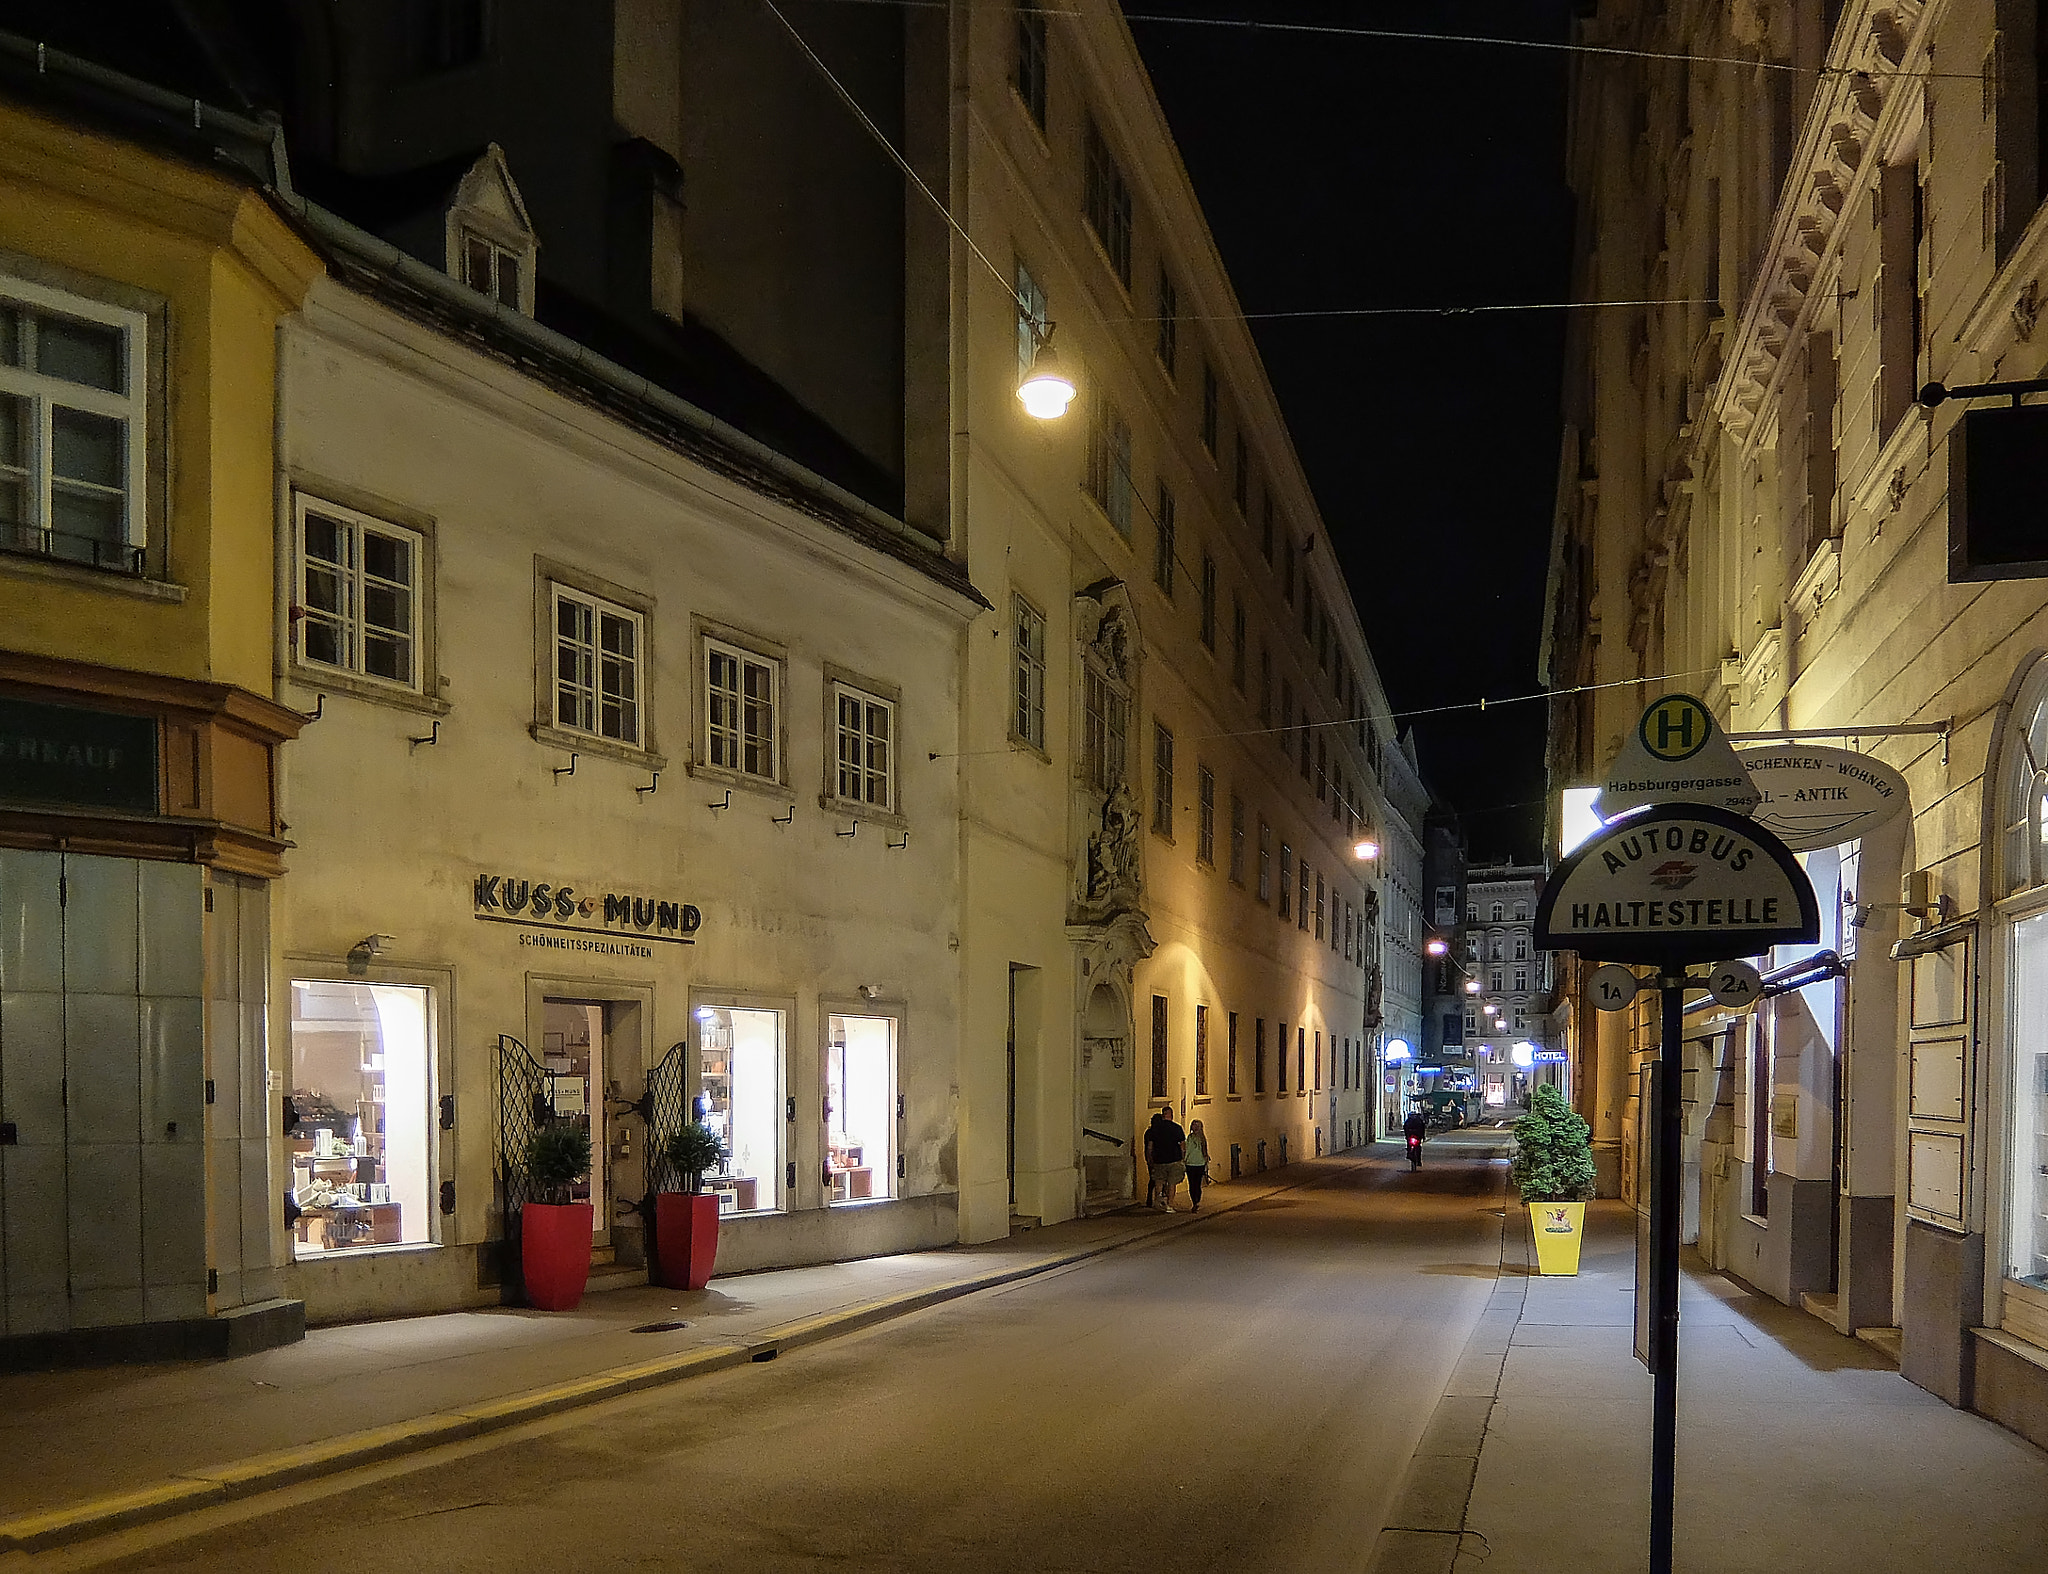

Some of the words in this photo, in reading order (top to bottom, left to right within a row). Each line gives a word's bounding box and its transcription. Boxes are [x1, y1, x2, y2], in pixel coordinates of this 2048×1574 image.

[1658, 707, 1693, 749] H
[1608, 776, 1743, 793] Habsburgergasse
[1838, 762, 1895, 799] WOHNEN
[1794, 786, 1849, 802] ANTIK
[1601, 826, 1753, 875] AUTOBUS
[474, 874, 575, 920] KUSS
[604, 893, 702, 936] MUND
[1572, 897, 1778, 929] HALTESTELLE
[519, 933, 652, 959] SCHÖNHEITSSPEZIALITÄTEN
[1600, 981, 1622, 1000] 1A
[1721, 975, 1749, 993] 2A
[1533, 1051, 1566, 1061] HOTEL
